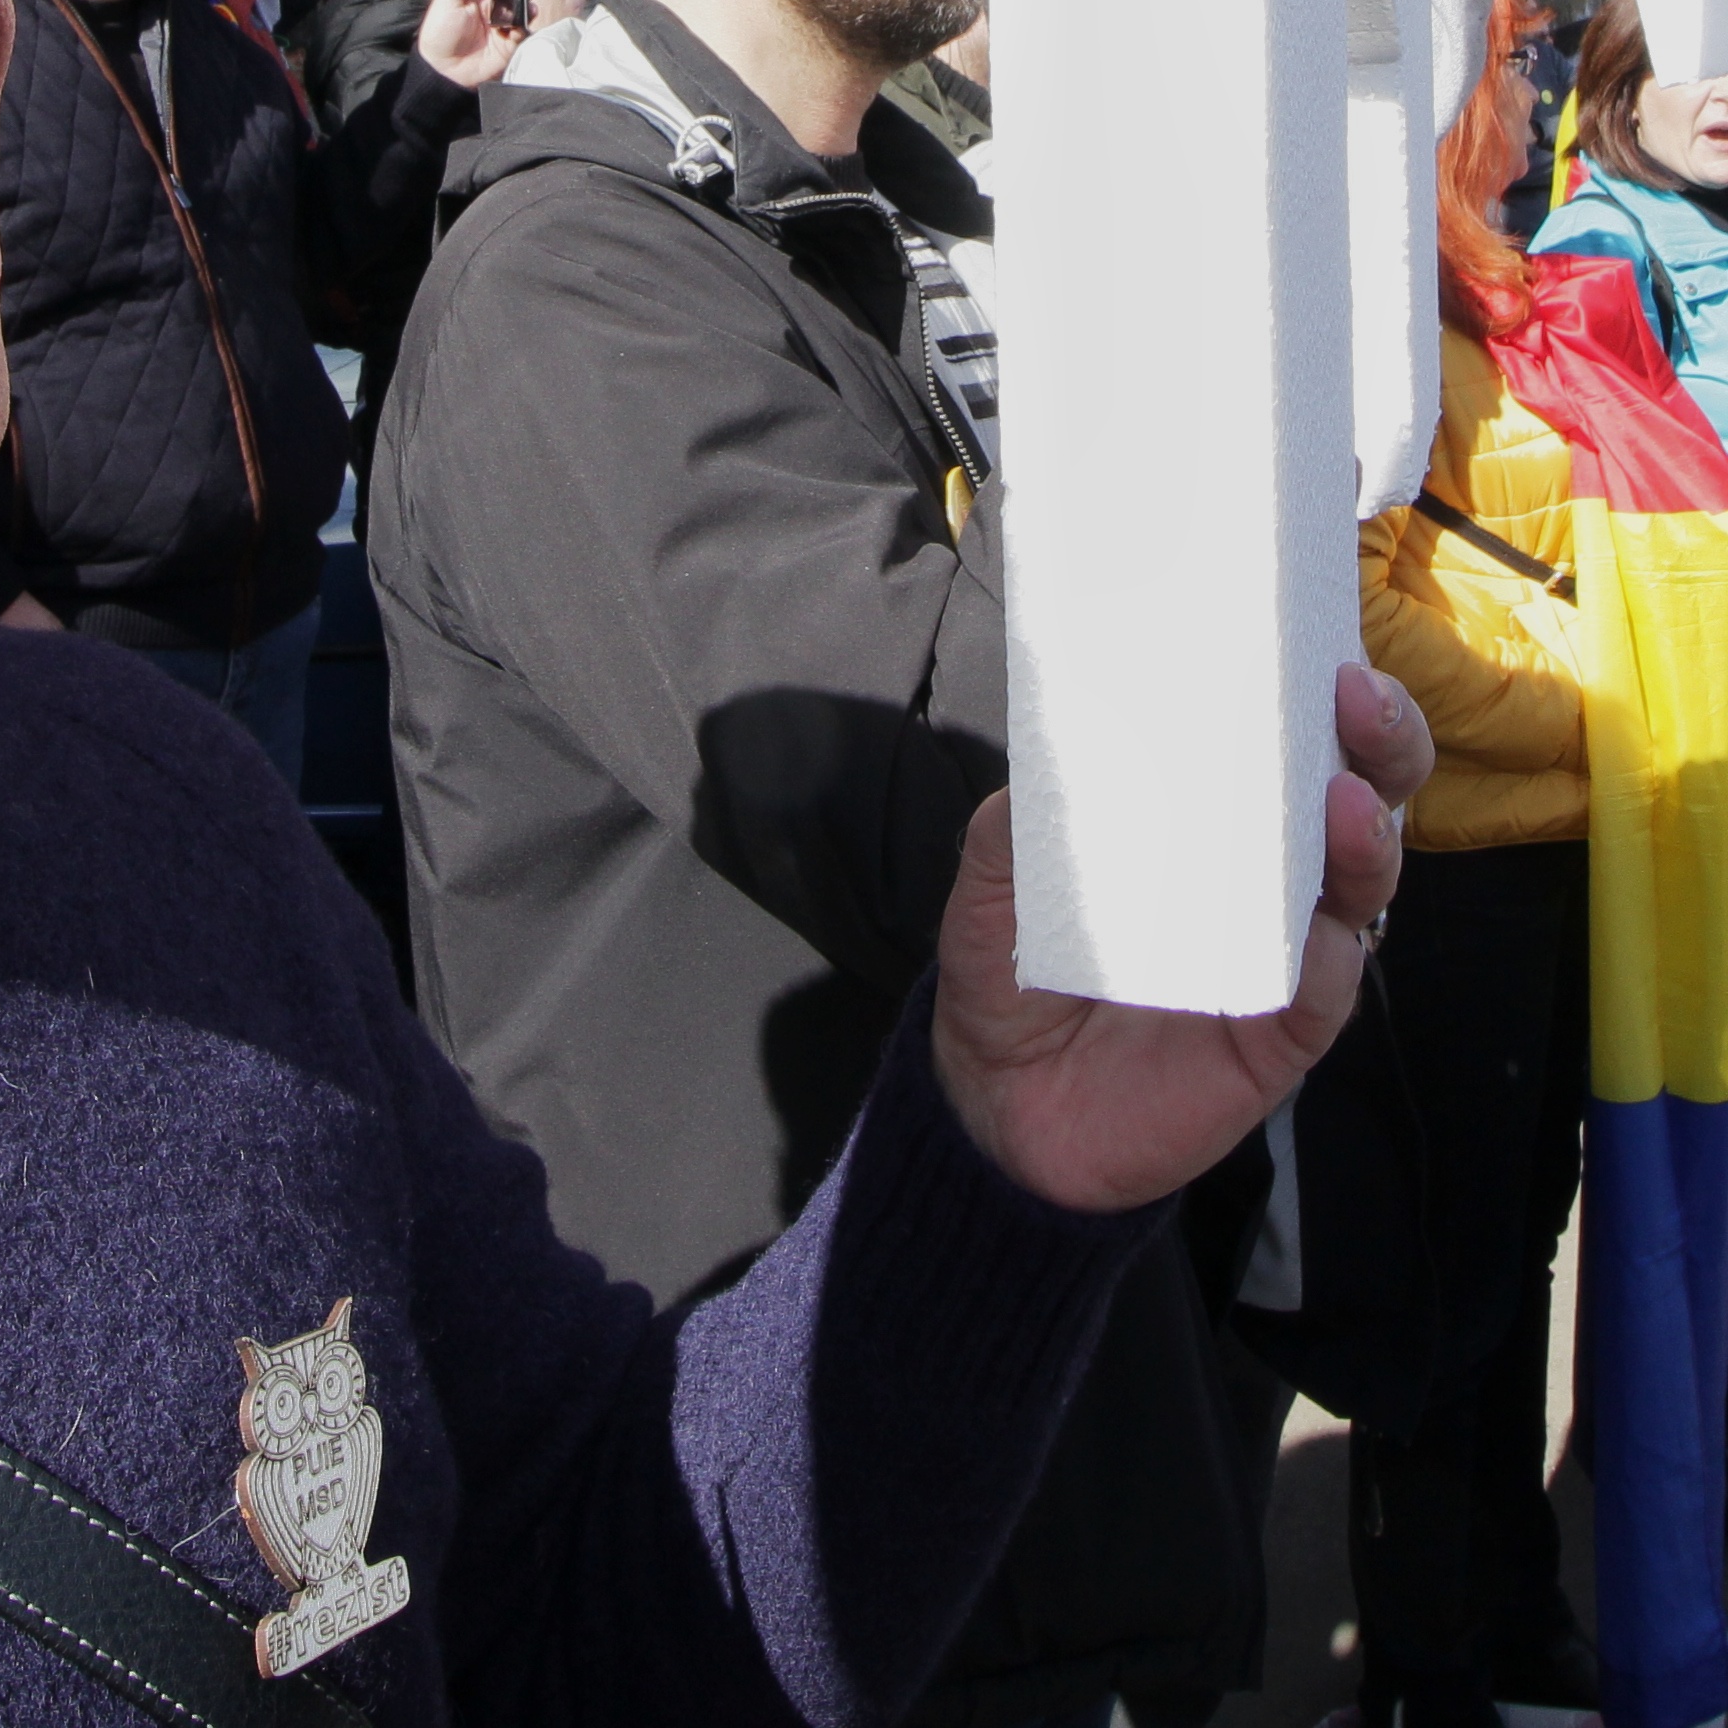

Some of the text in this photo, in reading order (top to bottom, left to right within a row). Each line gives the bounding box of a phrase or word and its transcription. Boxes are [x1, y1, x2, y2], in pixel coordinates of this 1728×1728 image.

[292, 1433, 344, 1485] PUIE
[297, 1477, 347, 1527] MSD
[266, 1558, 408, 1672] #rezist
